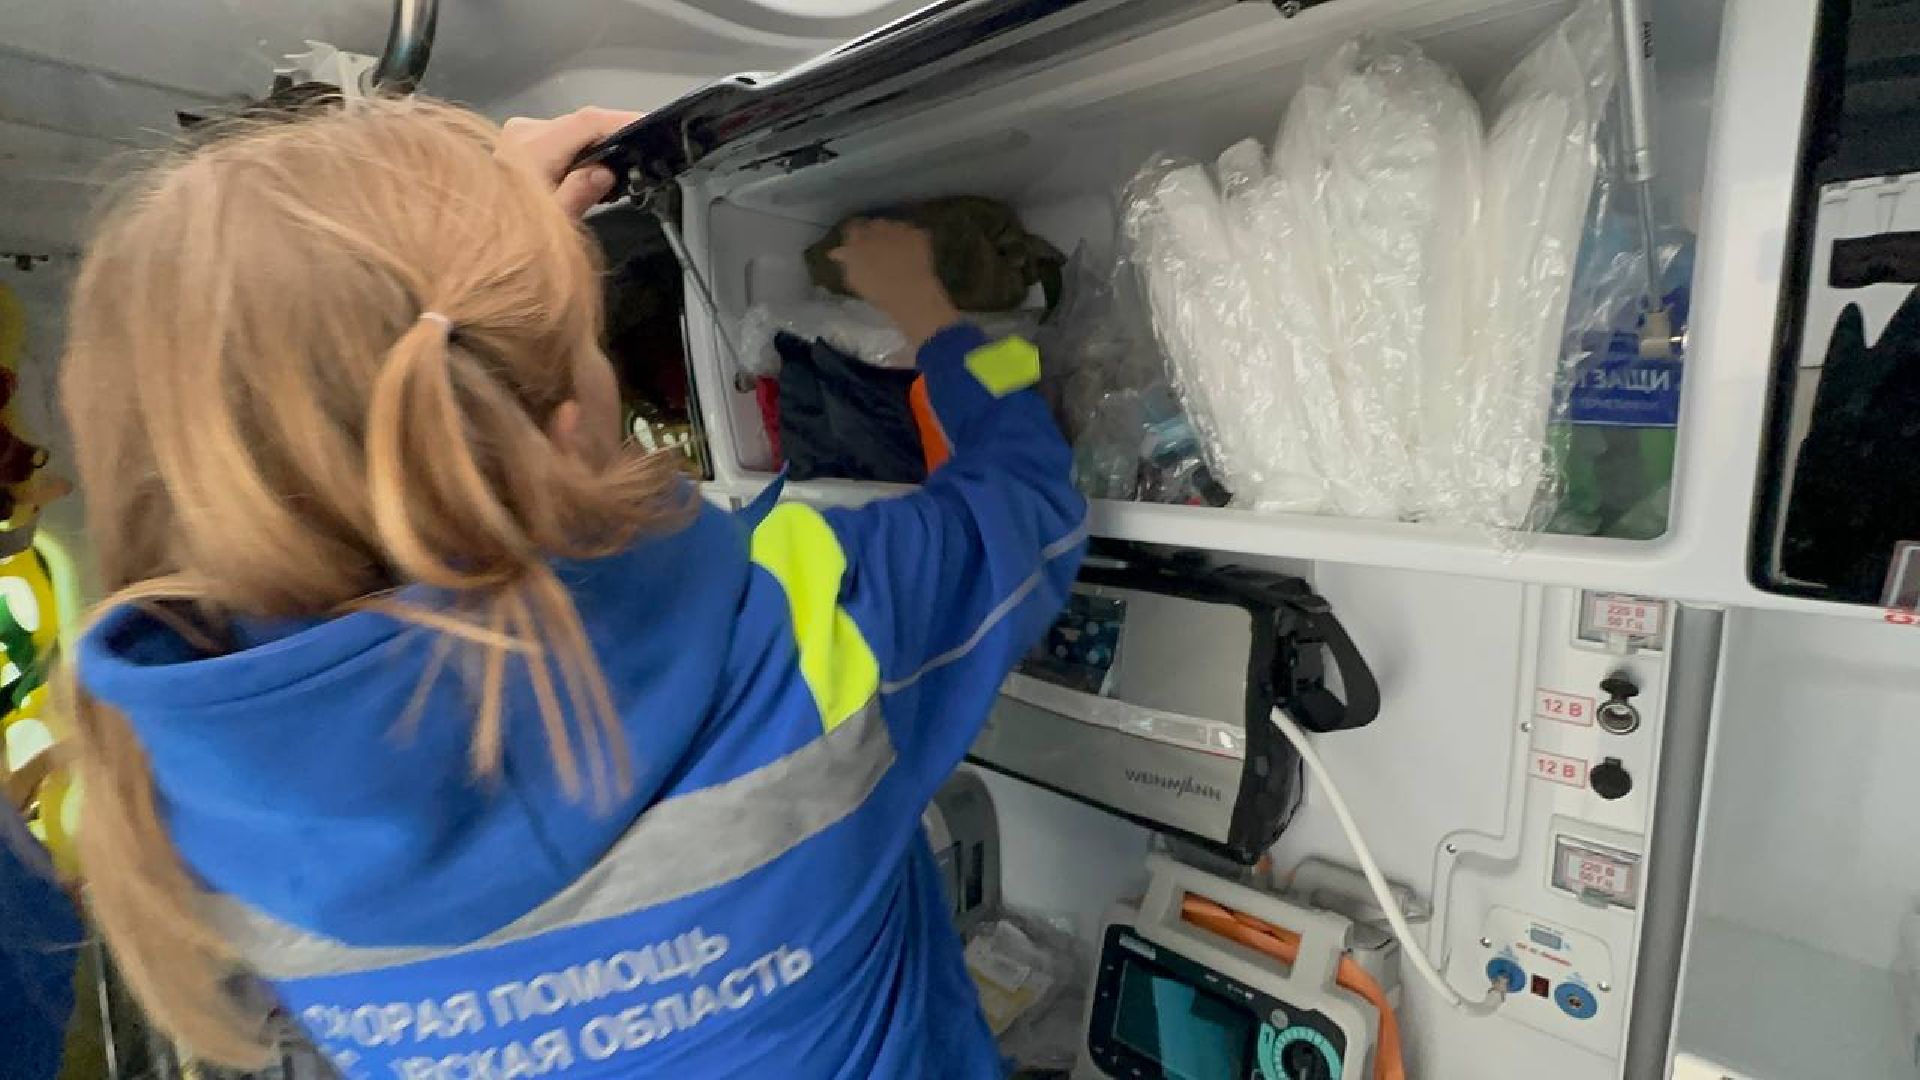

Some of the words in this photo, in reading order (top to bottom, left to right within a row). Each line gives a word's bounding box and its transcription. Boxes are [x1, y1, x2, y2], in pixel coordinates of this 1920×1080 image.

[1543, 698, 1563, 713] 12
[1569, 702, 1583, 717] В
[1537, 759, 1558, 774] 12
[1563, 764, 1576, 778] В
[488, 926, 730, 1028] ПОМОЩЬ
[579, 944, 814, 1061] ОБЛАСТЬ
